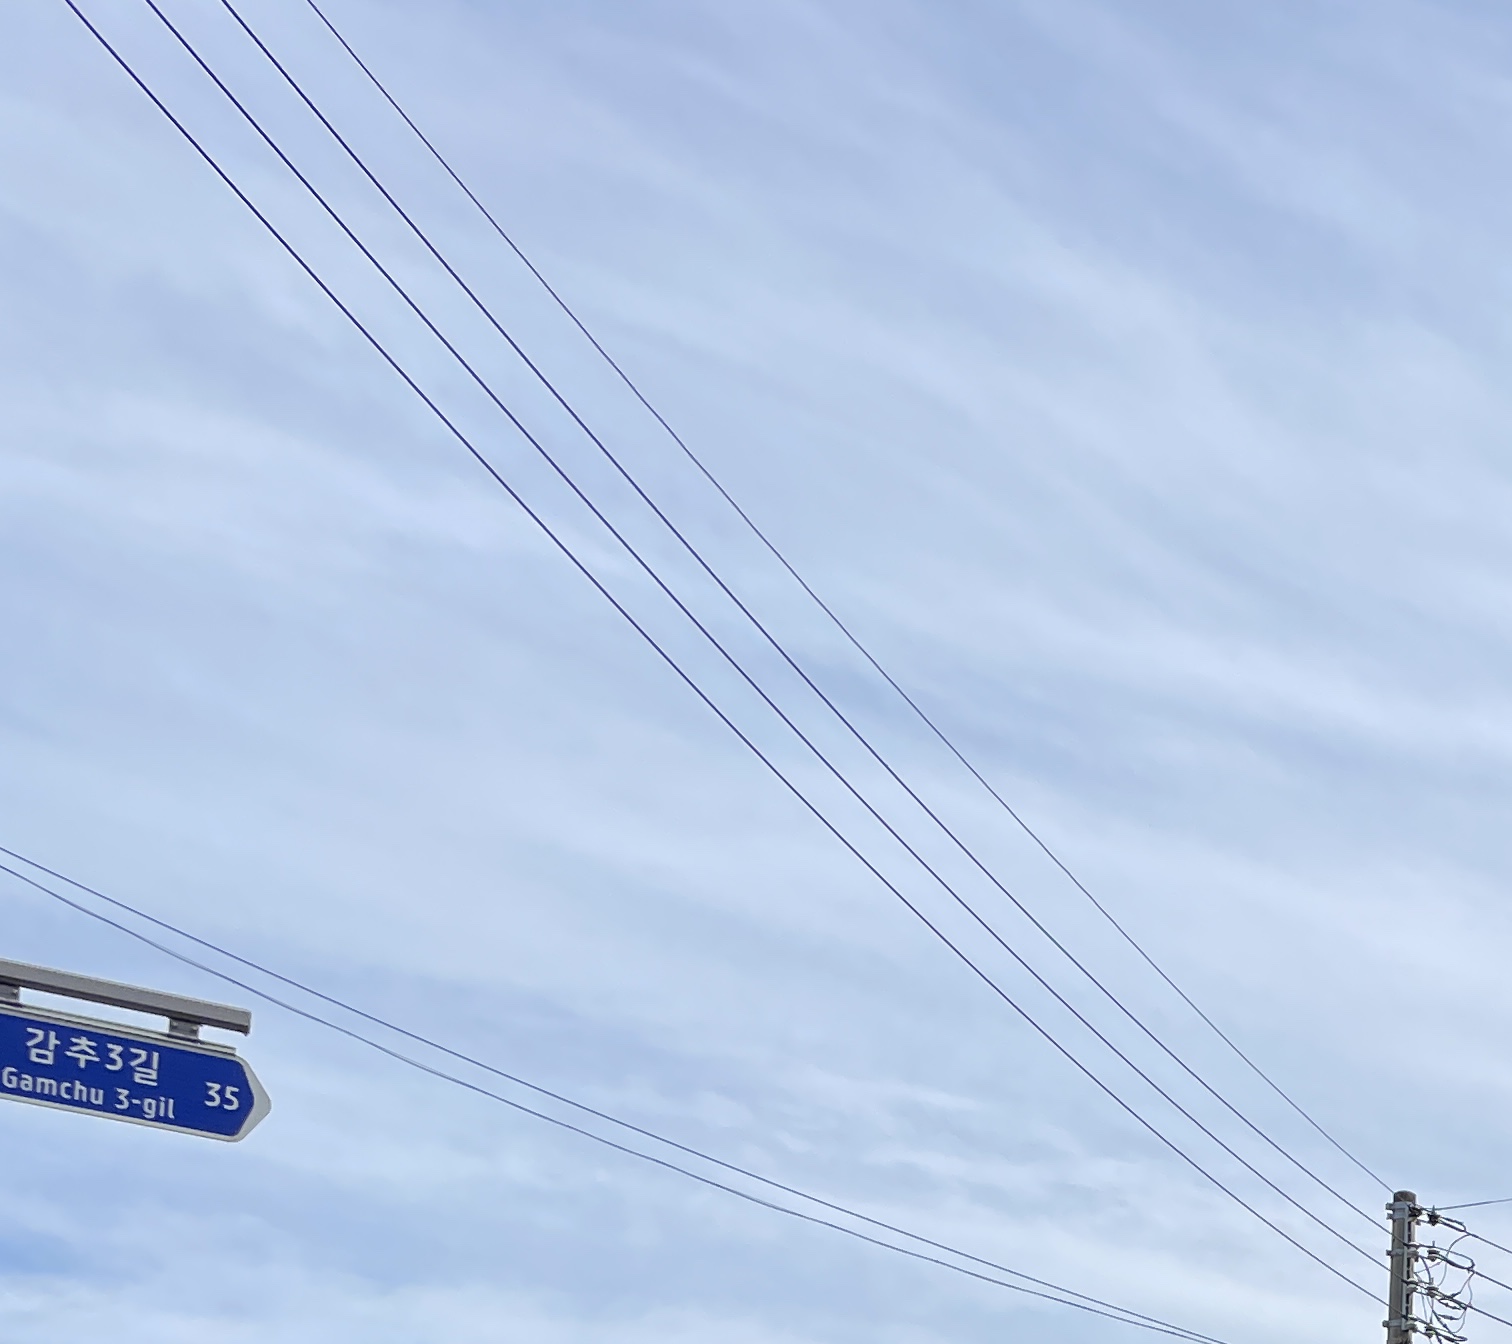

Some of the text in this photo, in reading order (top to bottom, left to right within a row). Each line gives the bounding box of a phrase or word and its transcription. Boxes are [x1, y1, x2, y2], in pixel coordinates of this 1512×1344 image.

[26, 1027, 161, 1087] 감추3길
[1, 1066, 175, 1120] Gamchu 3-gil
[204, 1081, 240, 1111] 35
